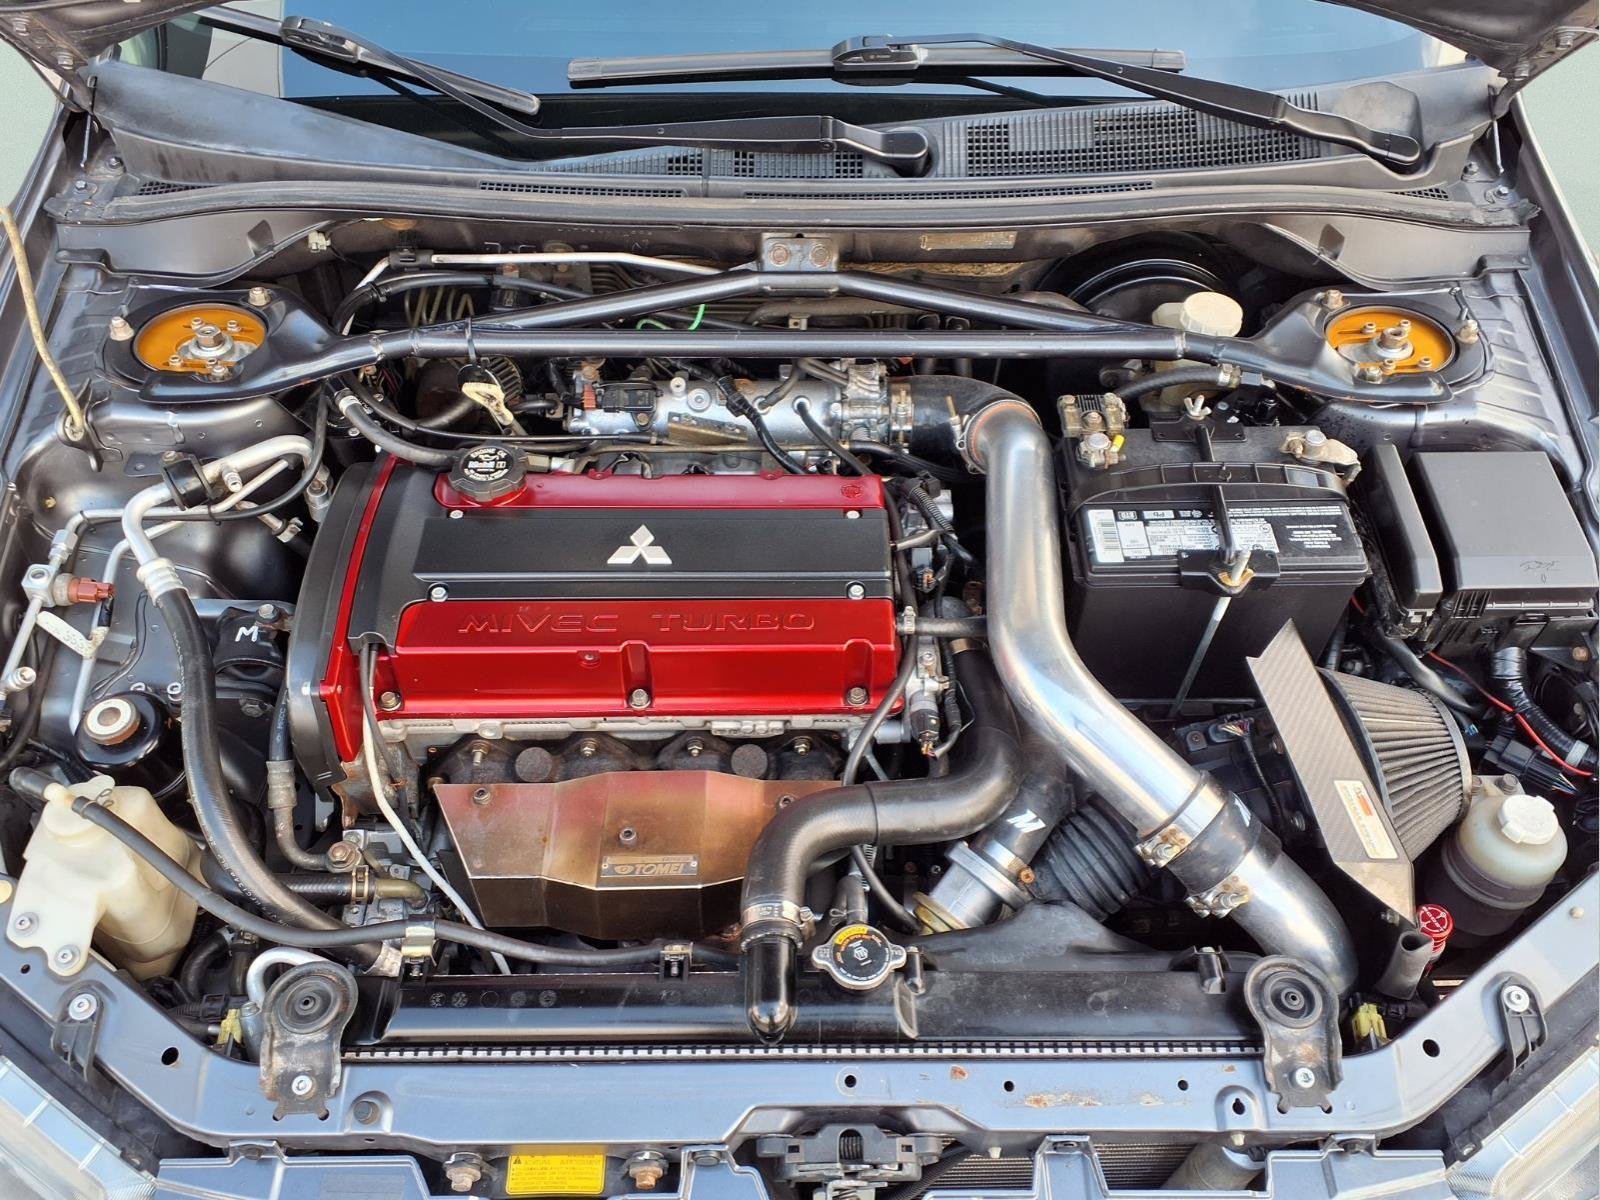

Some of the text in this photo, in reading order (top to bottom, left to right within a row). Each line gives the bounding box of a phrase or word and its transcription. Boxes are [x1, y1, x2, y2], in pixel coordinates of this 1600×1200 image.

[470, 448, 496, 458] ENGINE
[458, 613, 815, 632] MIVEC TURBO
[235, 625, 259, 642] M
[634, 863, 684, 875] TOMEI
[1421, 905, 1446, 932] BOOST
